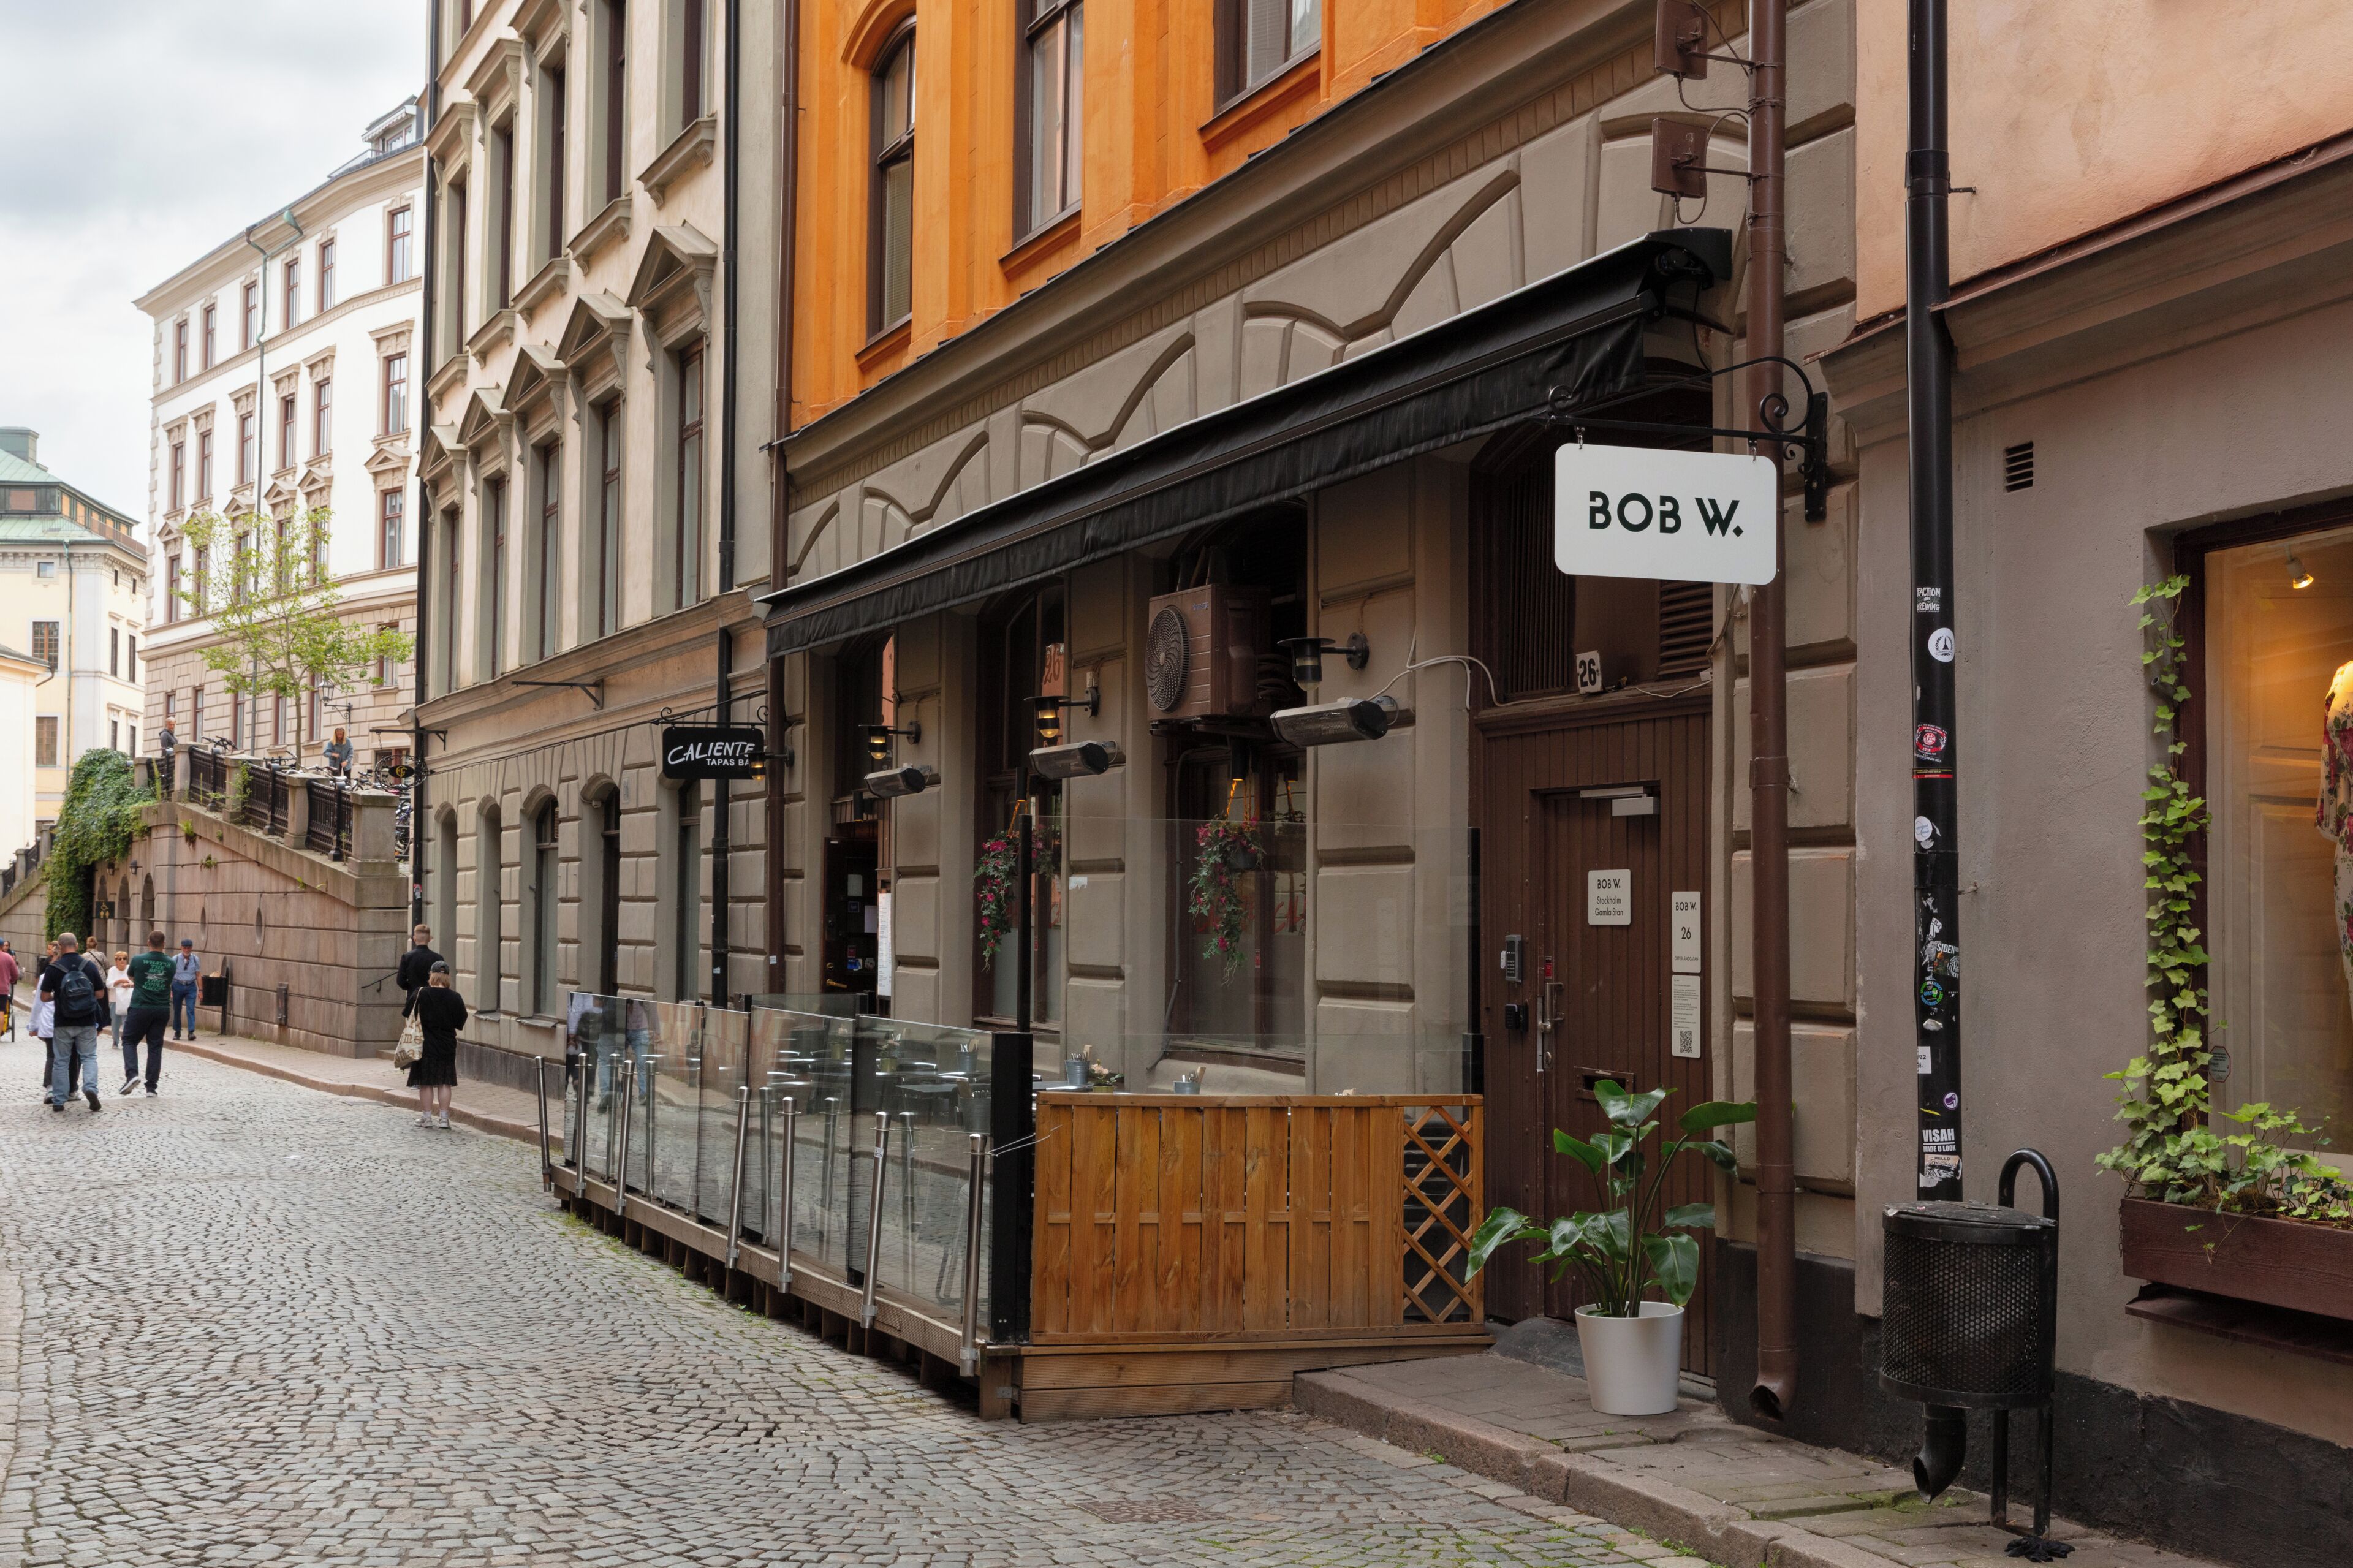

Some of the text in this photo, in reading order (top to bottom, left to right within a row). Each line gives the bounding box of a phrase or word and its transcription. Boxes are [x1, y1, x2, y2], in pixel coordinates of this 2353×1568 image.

[1589, 491, 1743, 537] BOB W.
[1916, 587, 1941, 597] FACTION
[1916, 602, 1940, 611] BREWING
[1578, 658, 1597, 687] 26
[667, 741, 756, 765] CALIENTE
[1597, 878, 1621, 889] BOB W.
[1597, 895, 1621, 904] Stockholm
[1595, 907, 1623, 916] Gamla Stan
[1675, 901, 1697, 911] BOB W.
[1681, 926, 1691, 939] 26
[1922, 1128, 1955, 1142] VISAH
